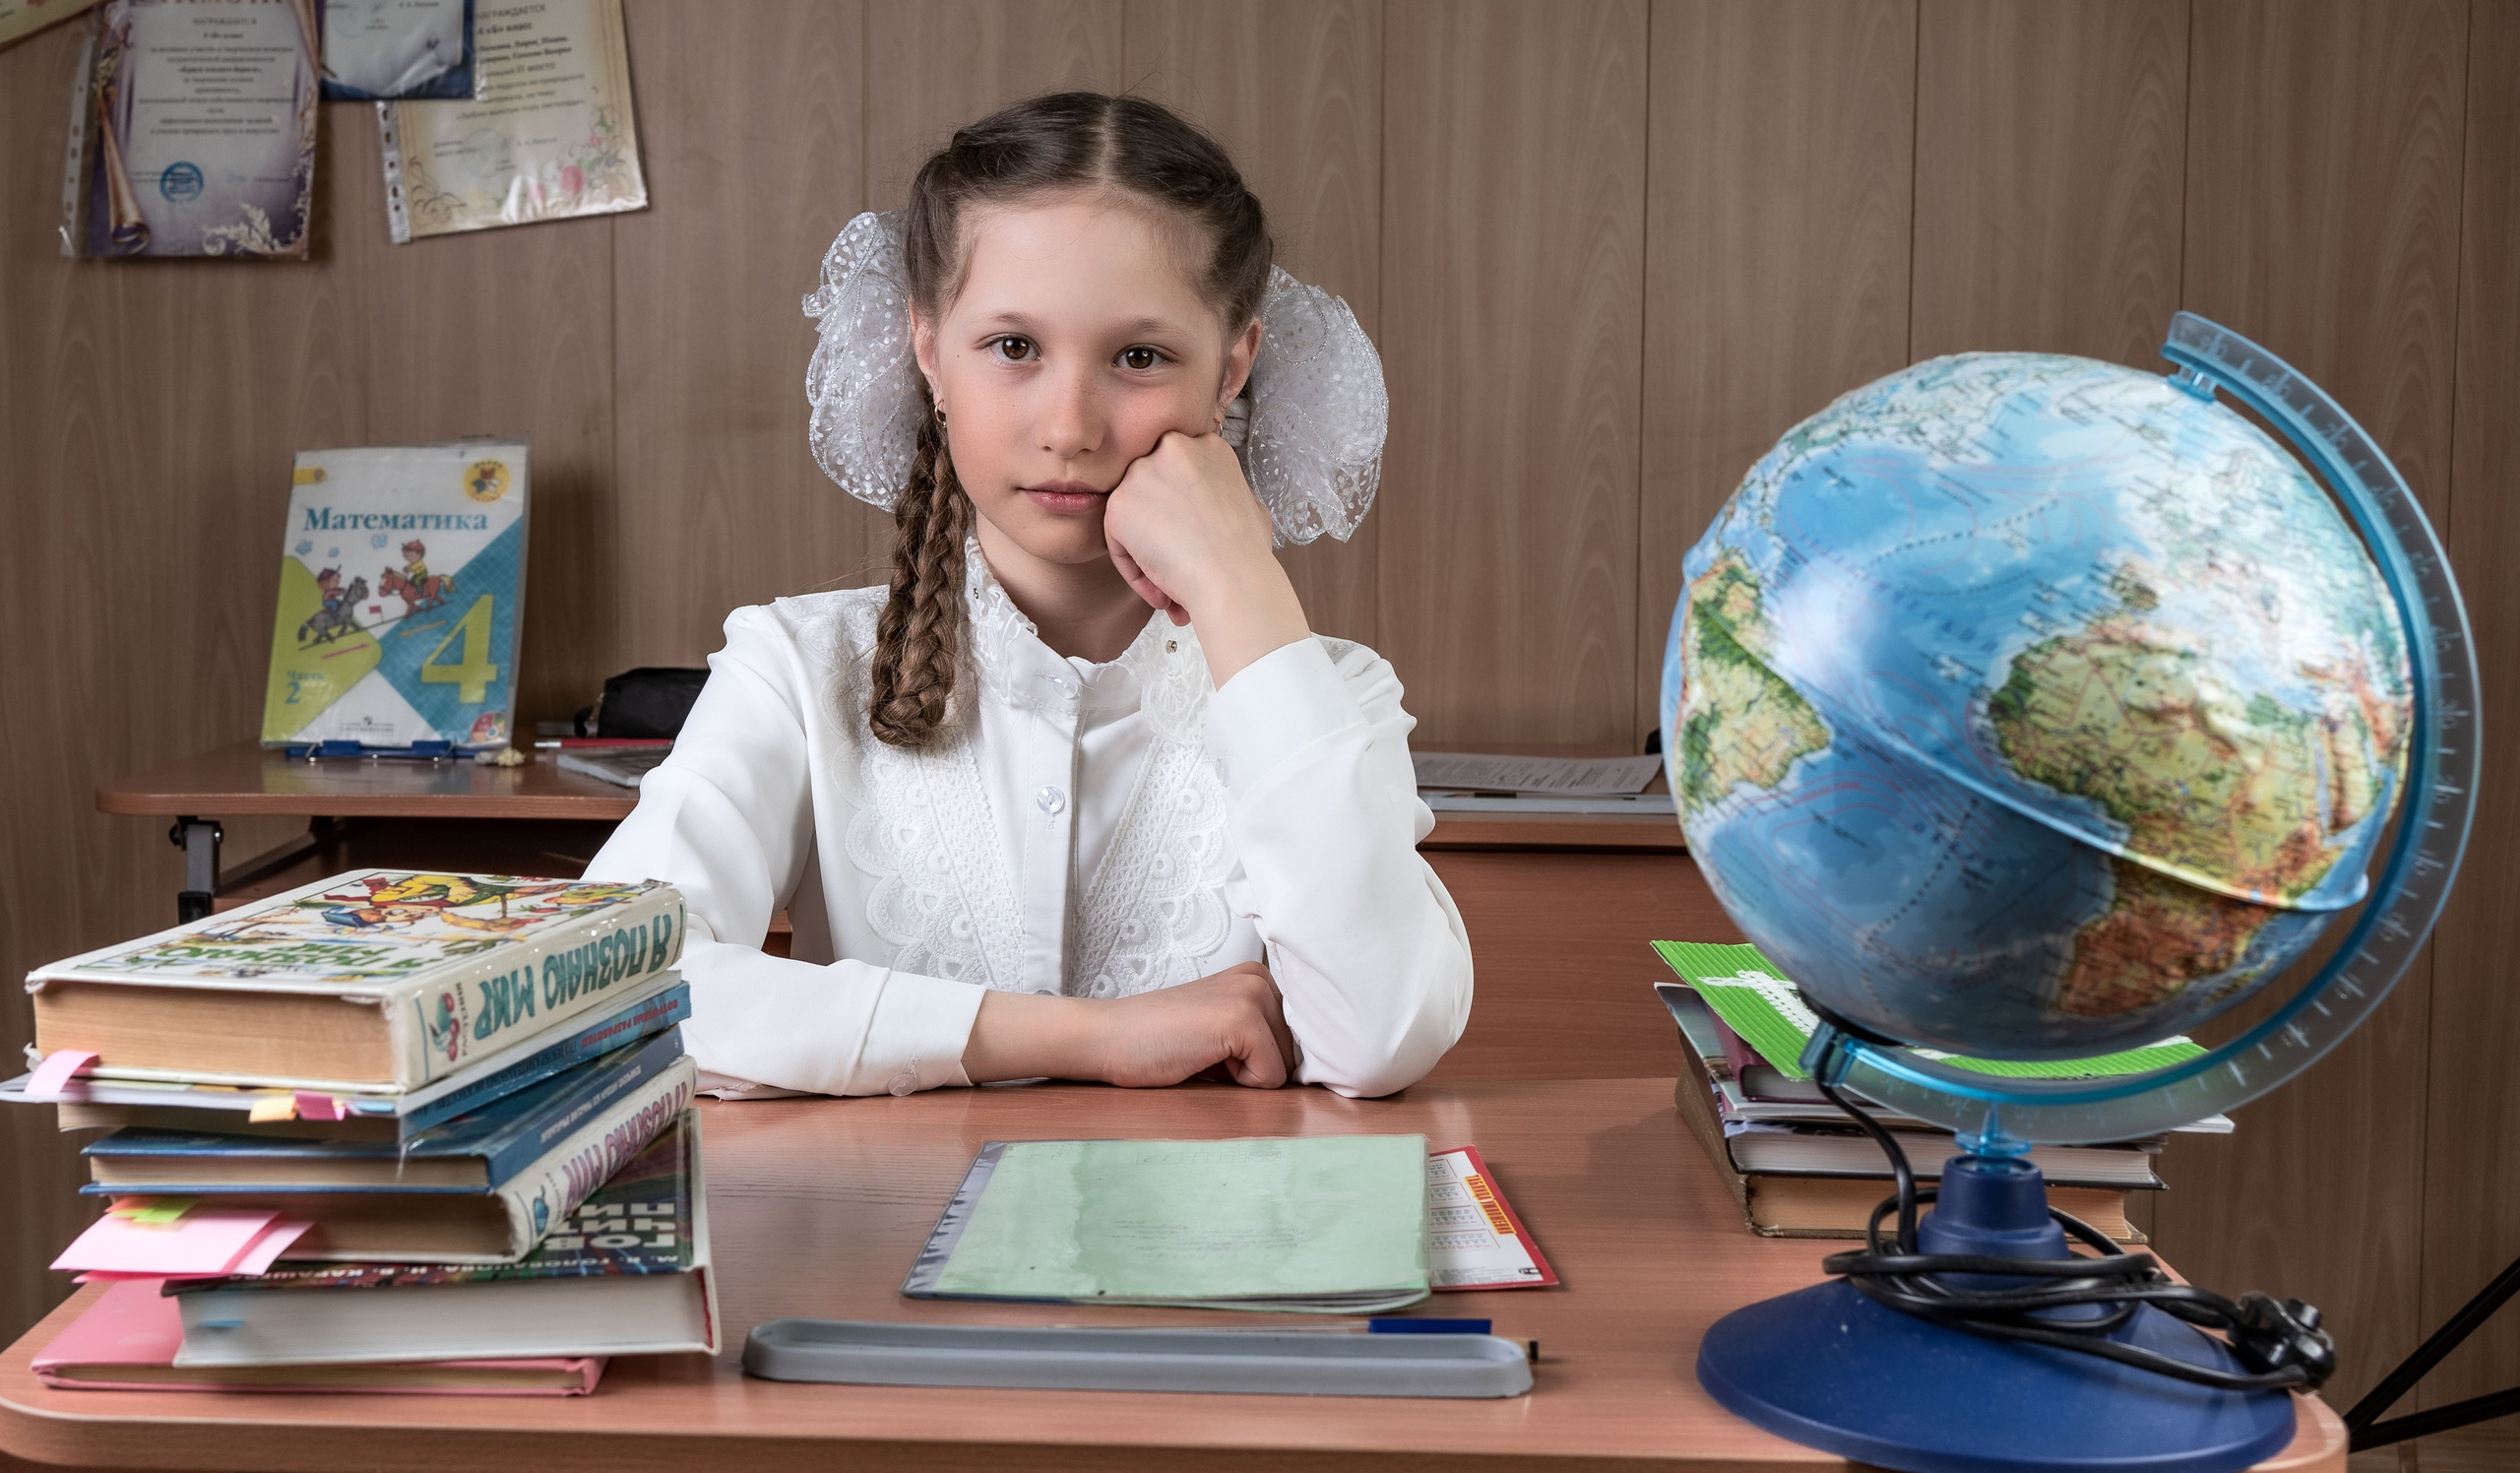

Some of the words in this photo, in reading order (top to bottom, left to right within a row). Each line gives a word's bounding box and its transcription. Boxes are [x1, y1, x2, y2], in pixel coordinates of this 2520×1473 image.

[303, 507, 489, 532] Математика
[420, 594, 498, 704] 4
[285, 670, 325, 681] Часть
[284, 681, 301, 705] 2
[155, 946, 391, 968] ПОЗНАЮ
[646, 915, 672, 975] Я
[543, 924, 649, 1011] ПОЗНАЮ
[472, 965, 536, 1042] МИР
[581, 1017, 633, 1047] РАЗРАБОТКИ
[577, 1202, 675, 1218] ПИ
[551, 1218, 677, 1235] ЧИТ
[543, 1233, 676, 1251] ГОВ
